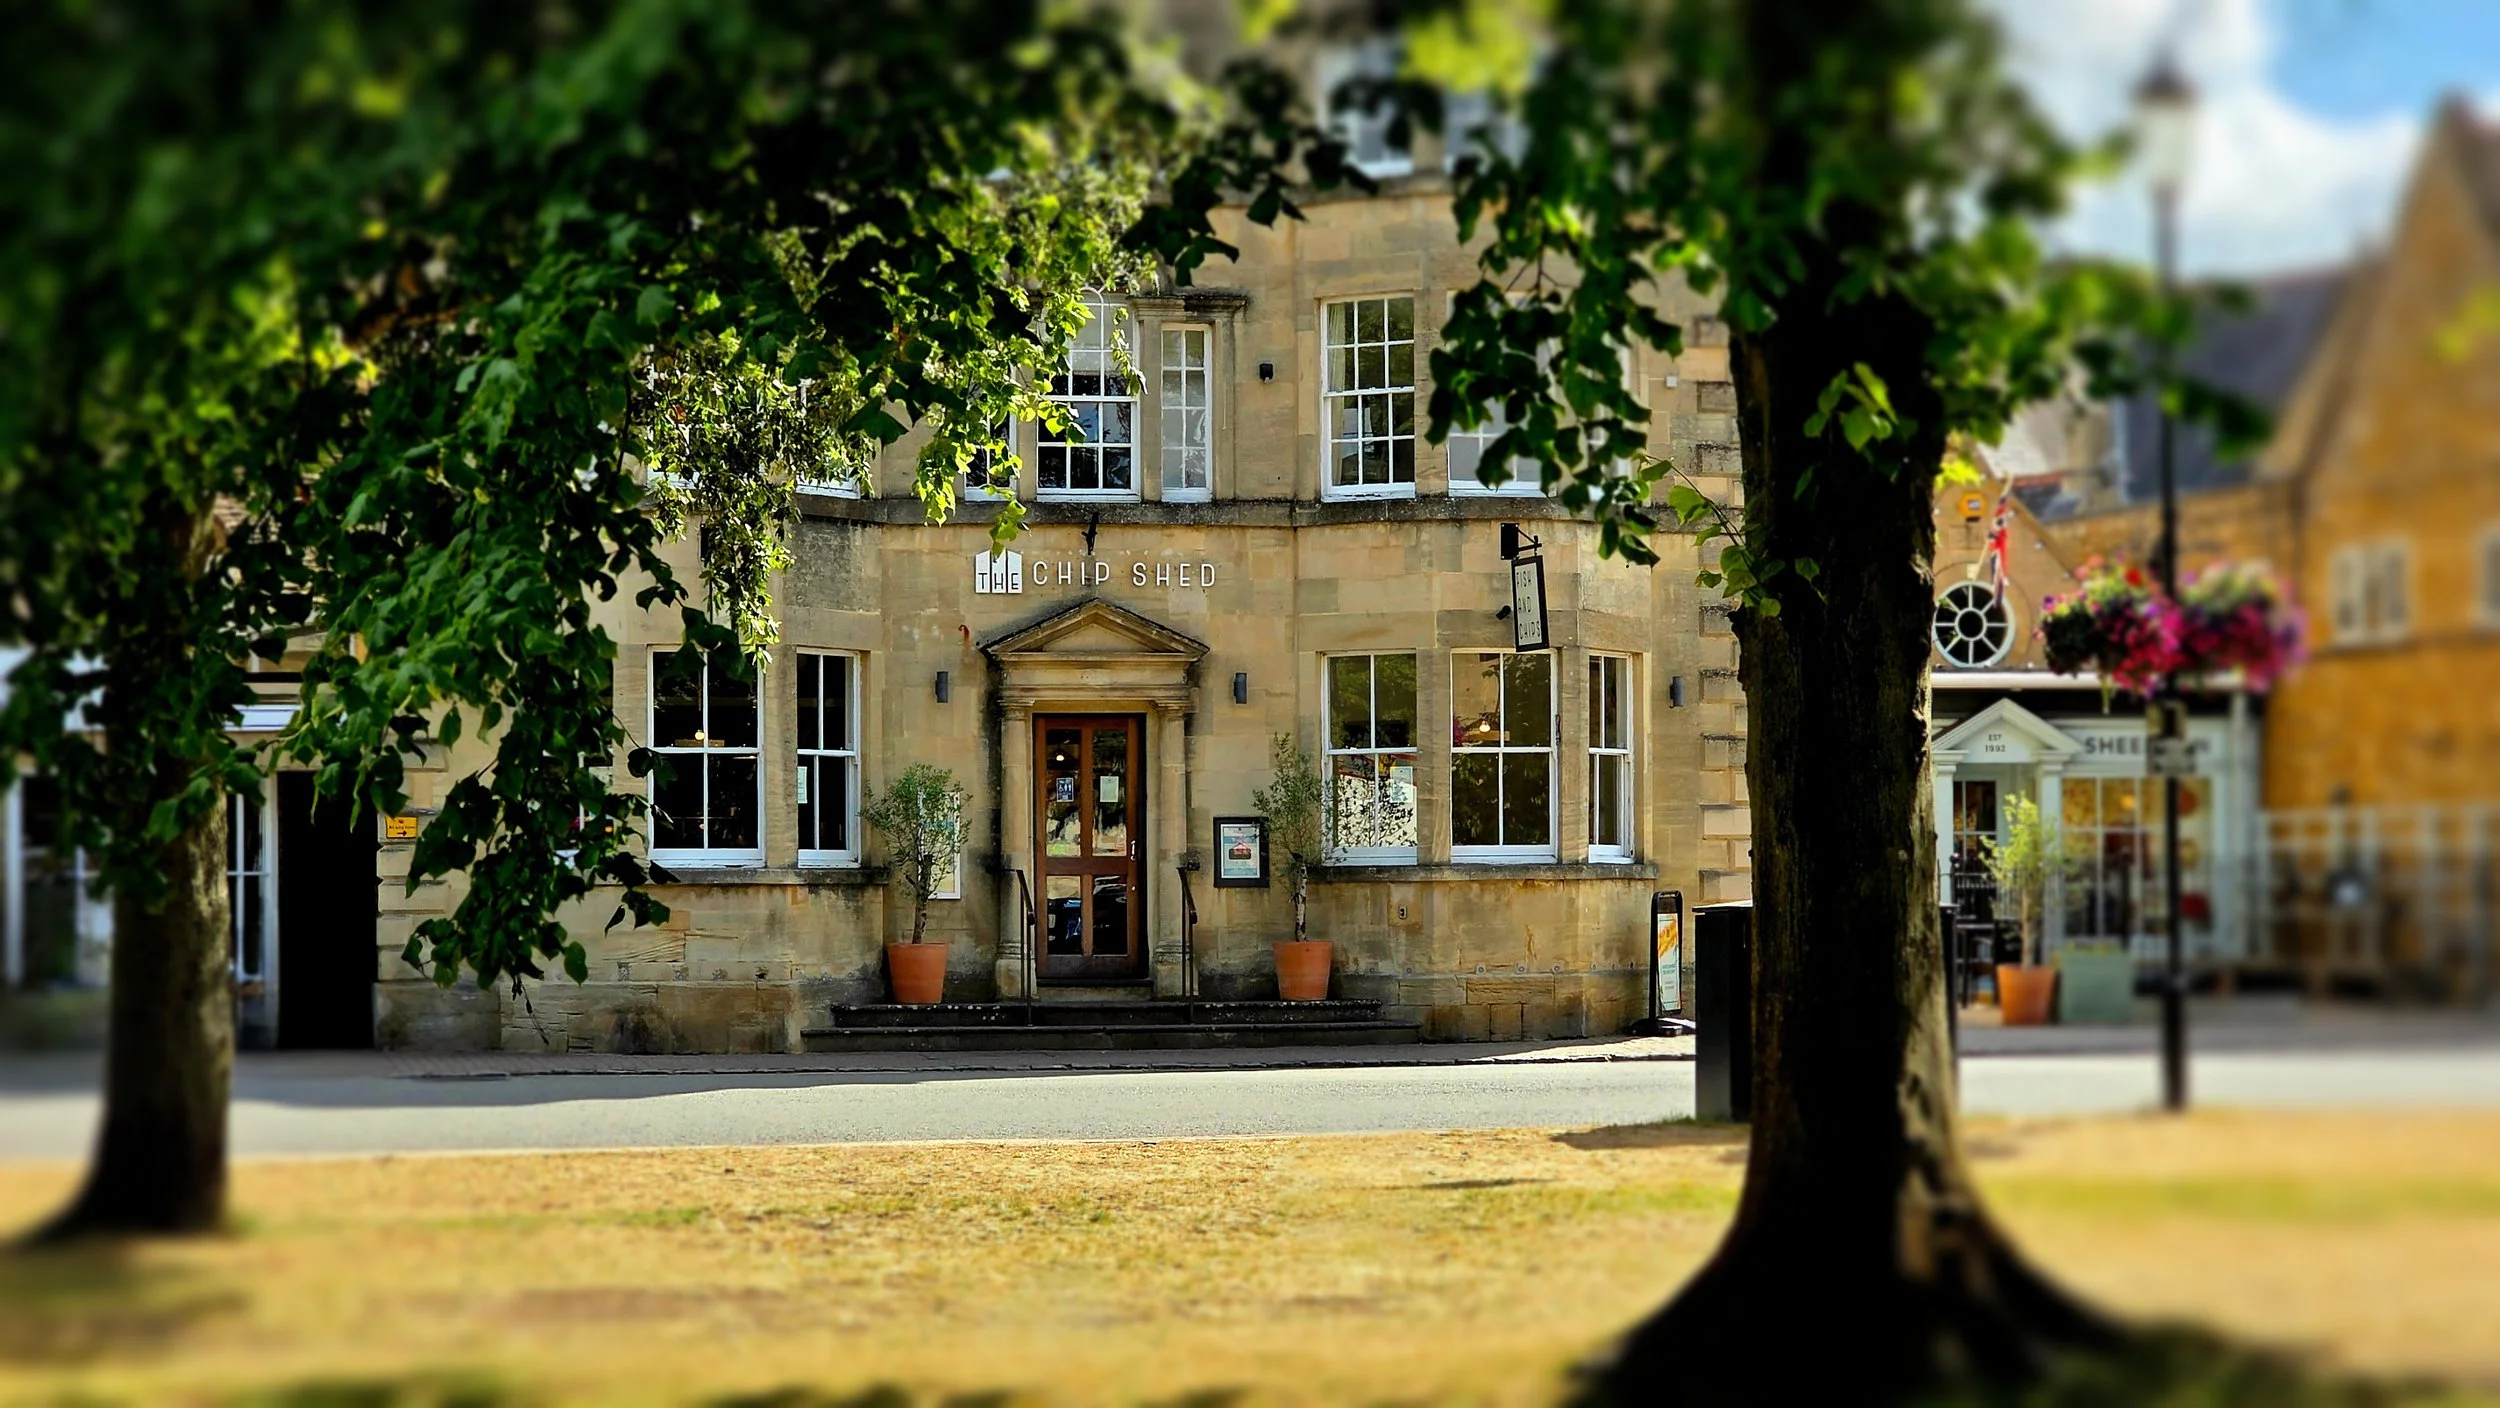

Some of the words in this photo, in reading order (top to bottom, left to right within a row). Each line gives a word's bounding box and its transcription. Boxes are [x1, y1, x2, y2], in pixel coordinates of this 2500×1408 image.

[978, 573, 1019, 590] THE
[1033, 561, 1110, 586] CHIP
[1132, 562, 1216, 587] SHED
[1516, 570, 1532, 588] FISH
[1517, 596, 1532, 613] AND
[1519, 620, 1541, 640] CHIPS
[1988, 733, 2002, 742] EST
